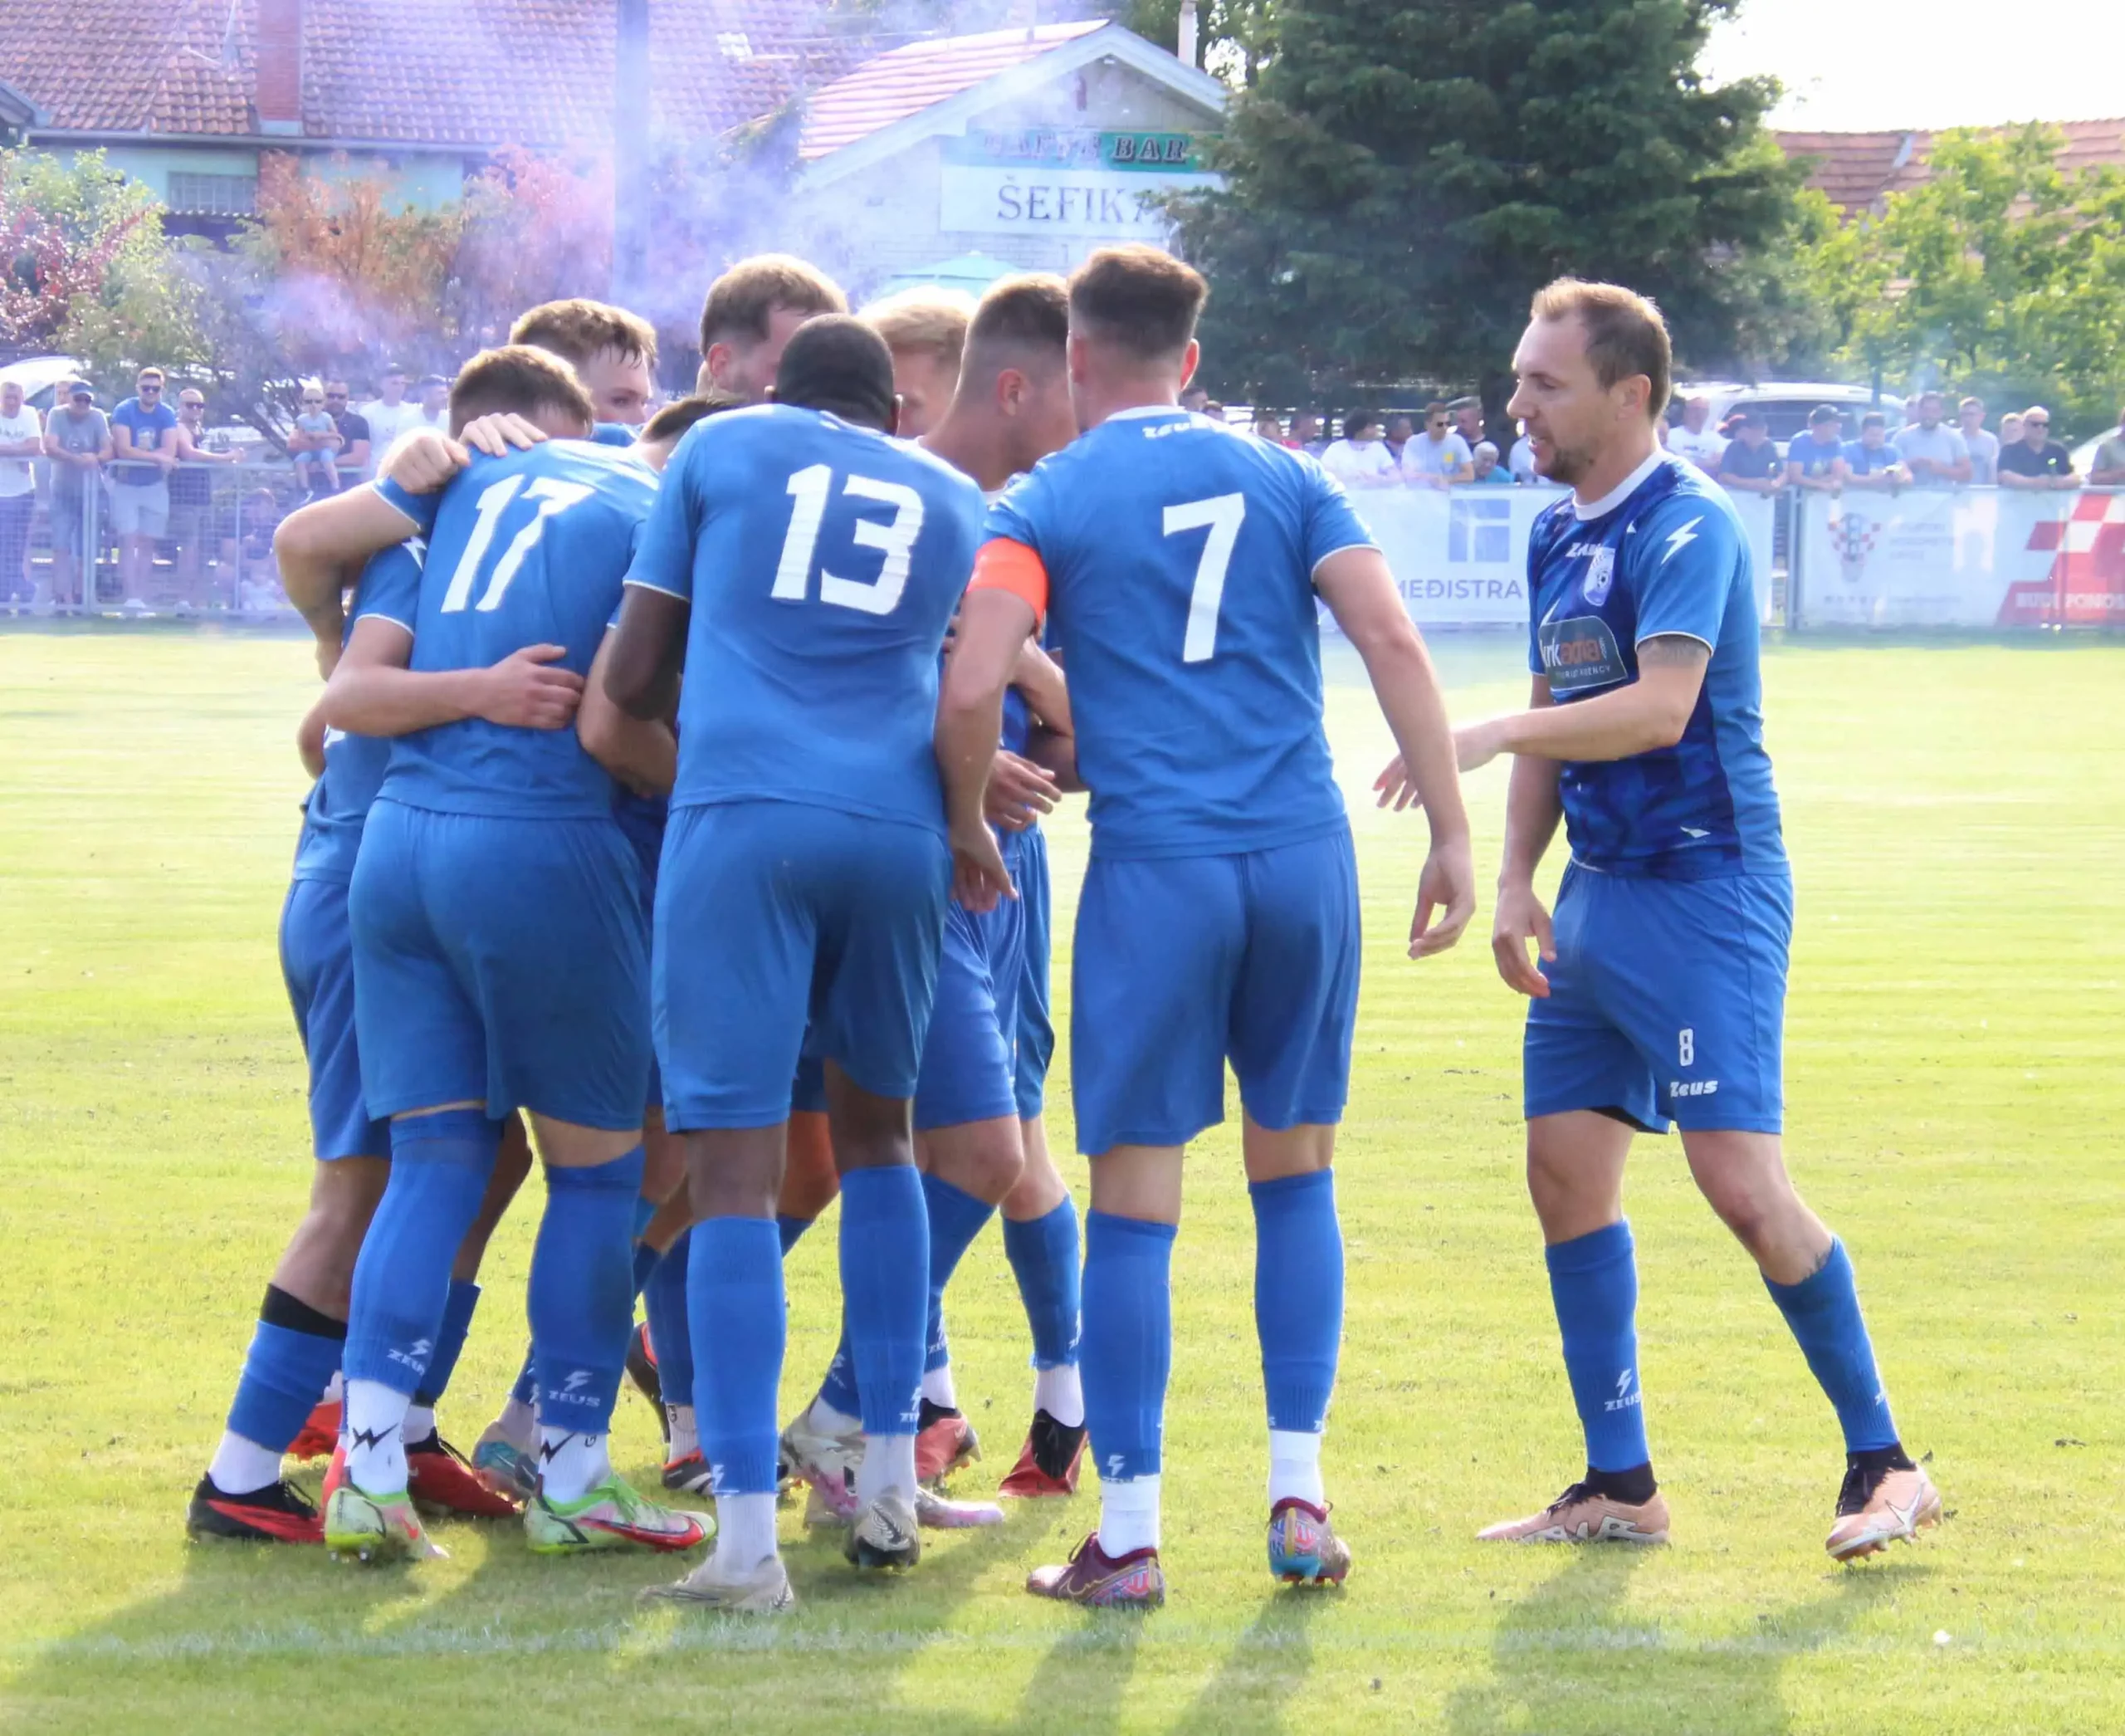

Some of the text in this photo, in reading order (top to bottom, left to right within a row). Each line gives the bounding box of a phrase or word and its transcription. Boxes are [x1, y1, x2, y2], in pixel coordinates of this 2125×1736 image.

[1111, 135, 1187, 164] BAR
[440, 472, 596, 614] 17
[770, 463, 925, 616] 13
[1163, 492, 1245, 663] 7
[1679, 1028, 1694, 1067] 8
[549, 1390, 601, 1407] ZEUS
